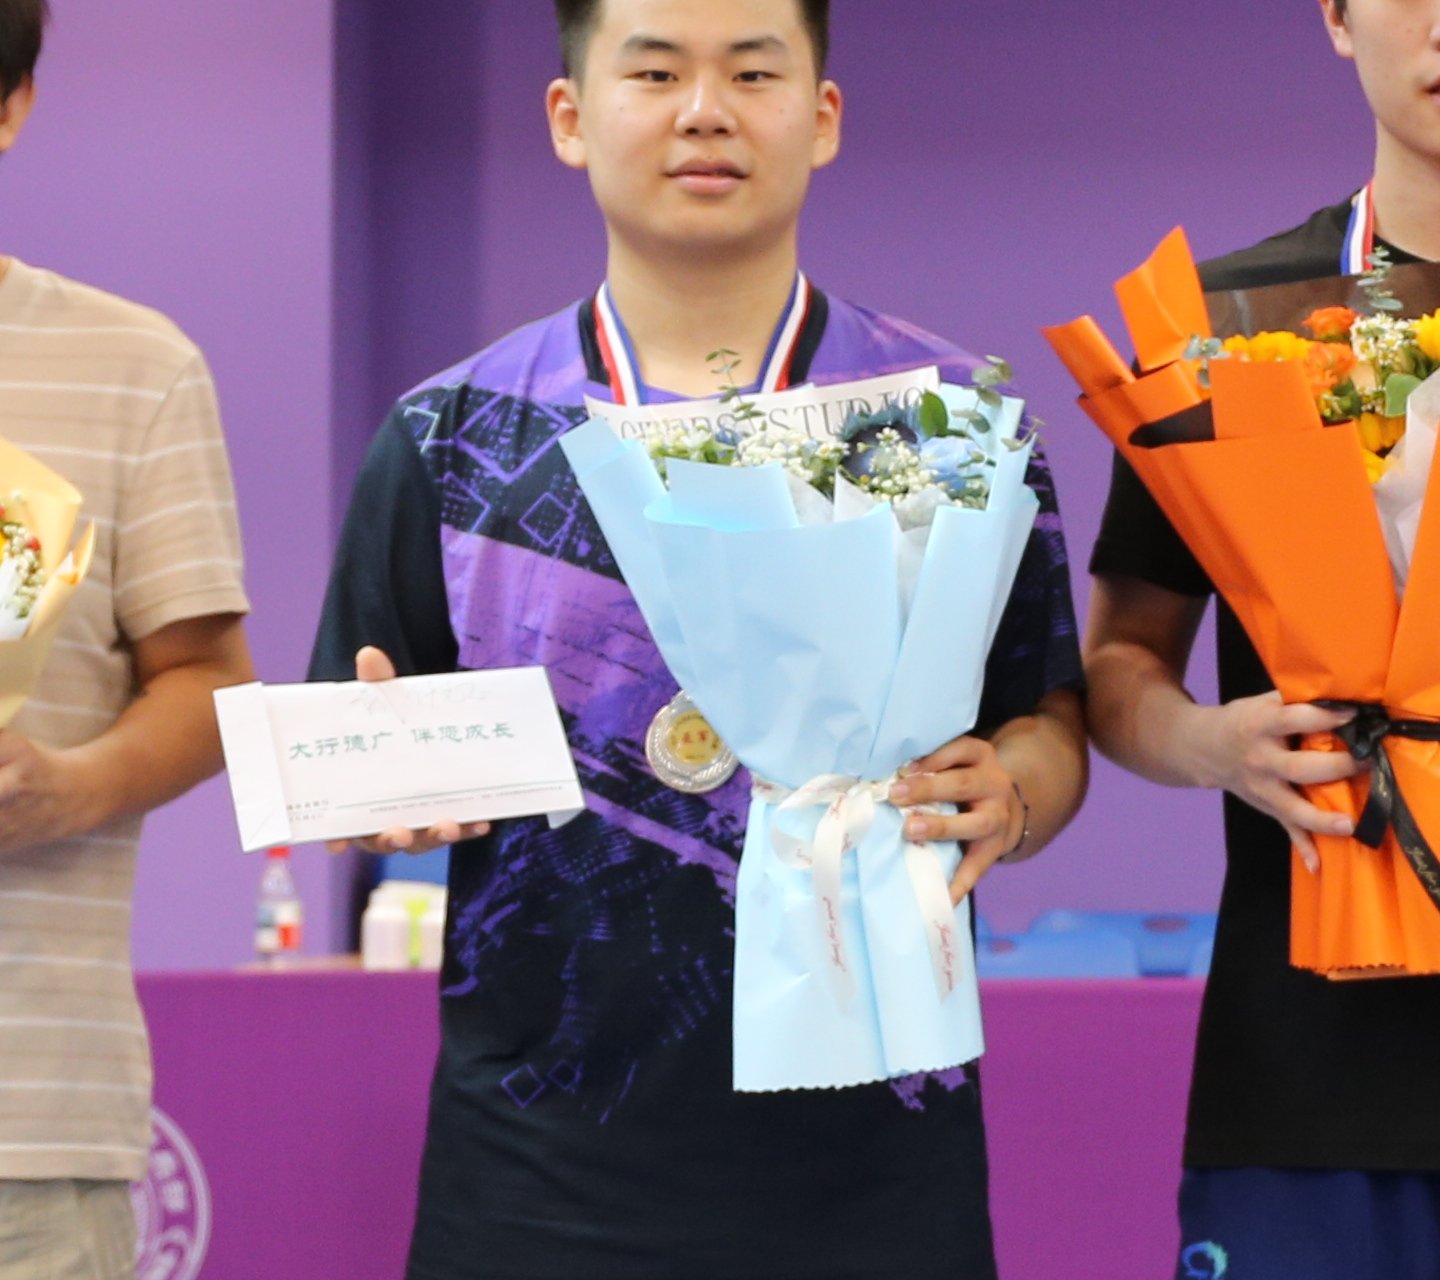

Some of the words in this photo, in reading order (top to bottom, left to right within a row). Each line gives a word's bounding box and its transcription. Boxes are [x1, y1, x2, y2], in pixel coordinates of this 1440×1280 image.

[289, 731, 393, 759] 大行德广
[411, 722, 515, 744] 伴您成长
